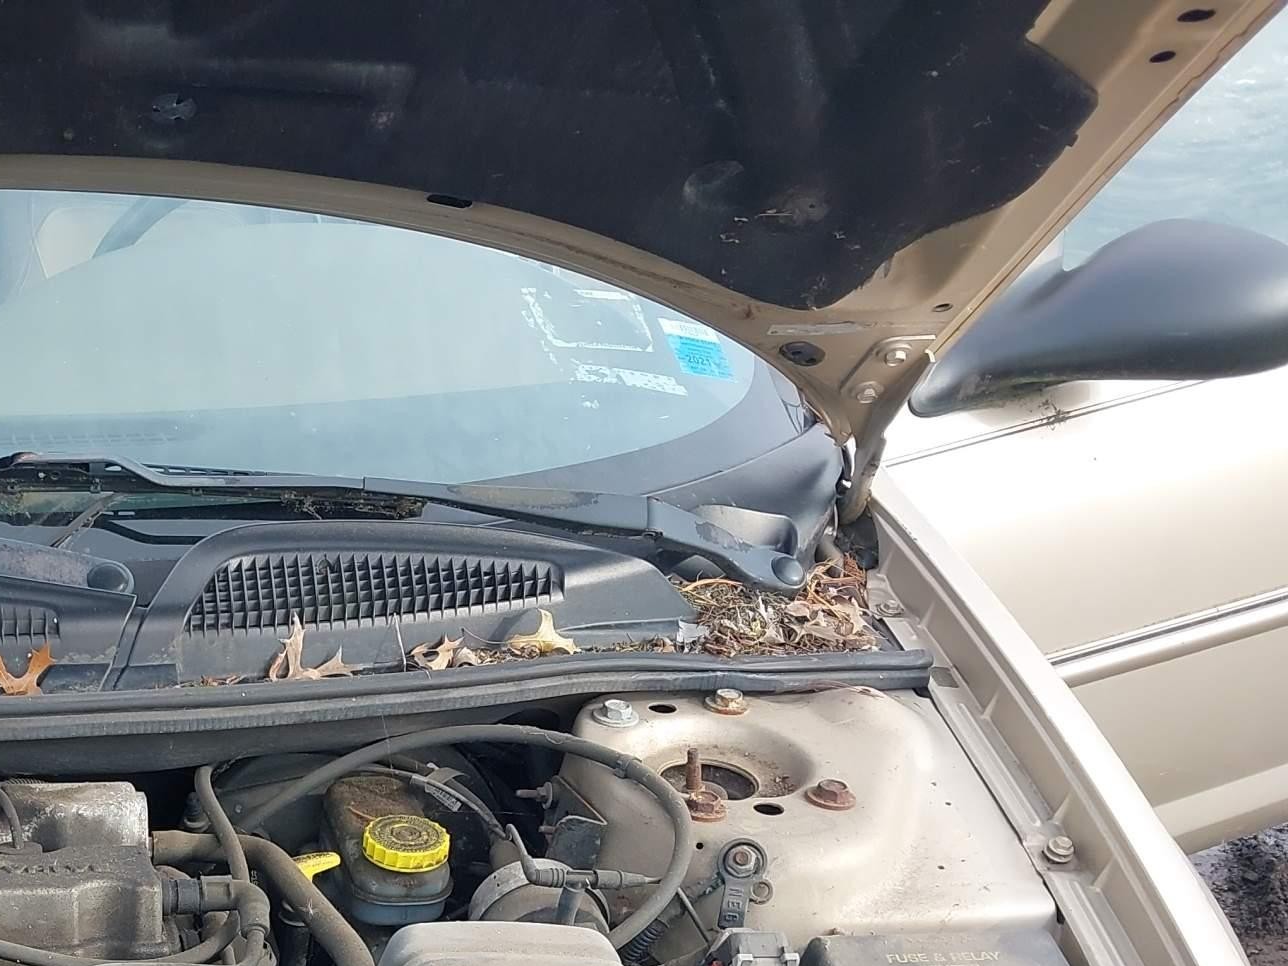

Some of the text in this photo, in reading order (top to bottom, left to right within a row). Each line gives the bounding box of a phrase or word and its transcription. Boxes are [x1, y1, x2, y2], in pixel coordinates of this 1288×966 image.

[724, 887, 745, 921] NEG
[886, 953, 930, 964] FUSE
[950, 951, 1001, 962] RELAY
